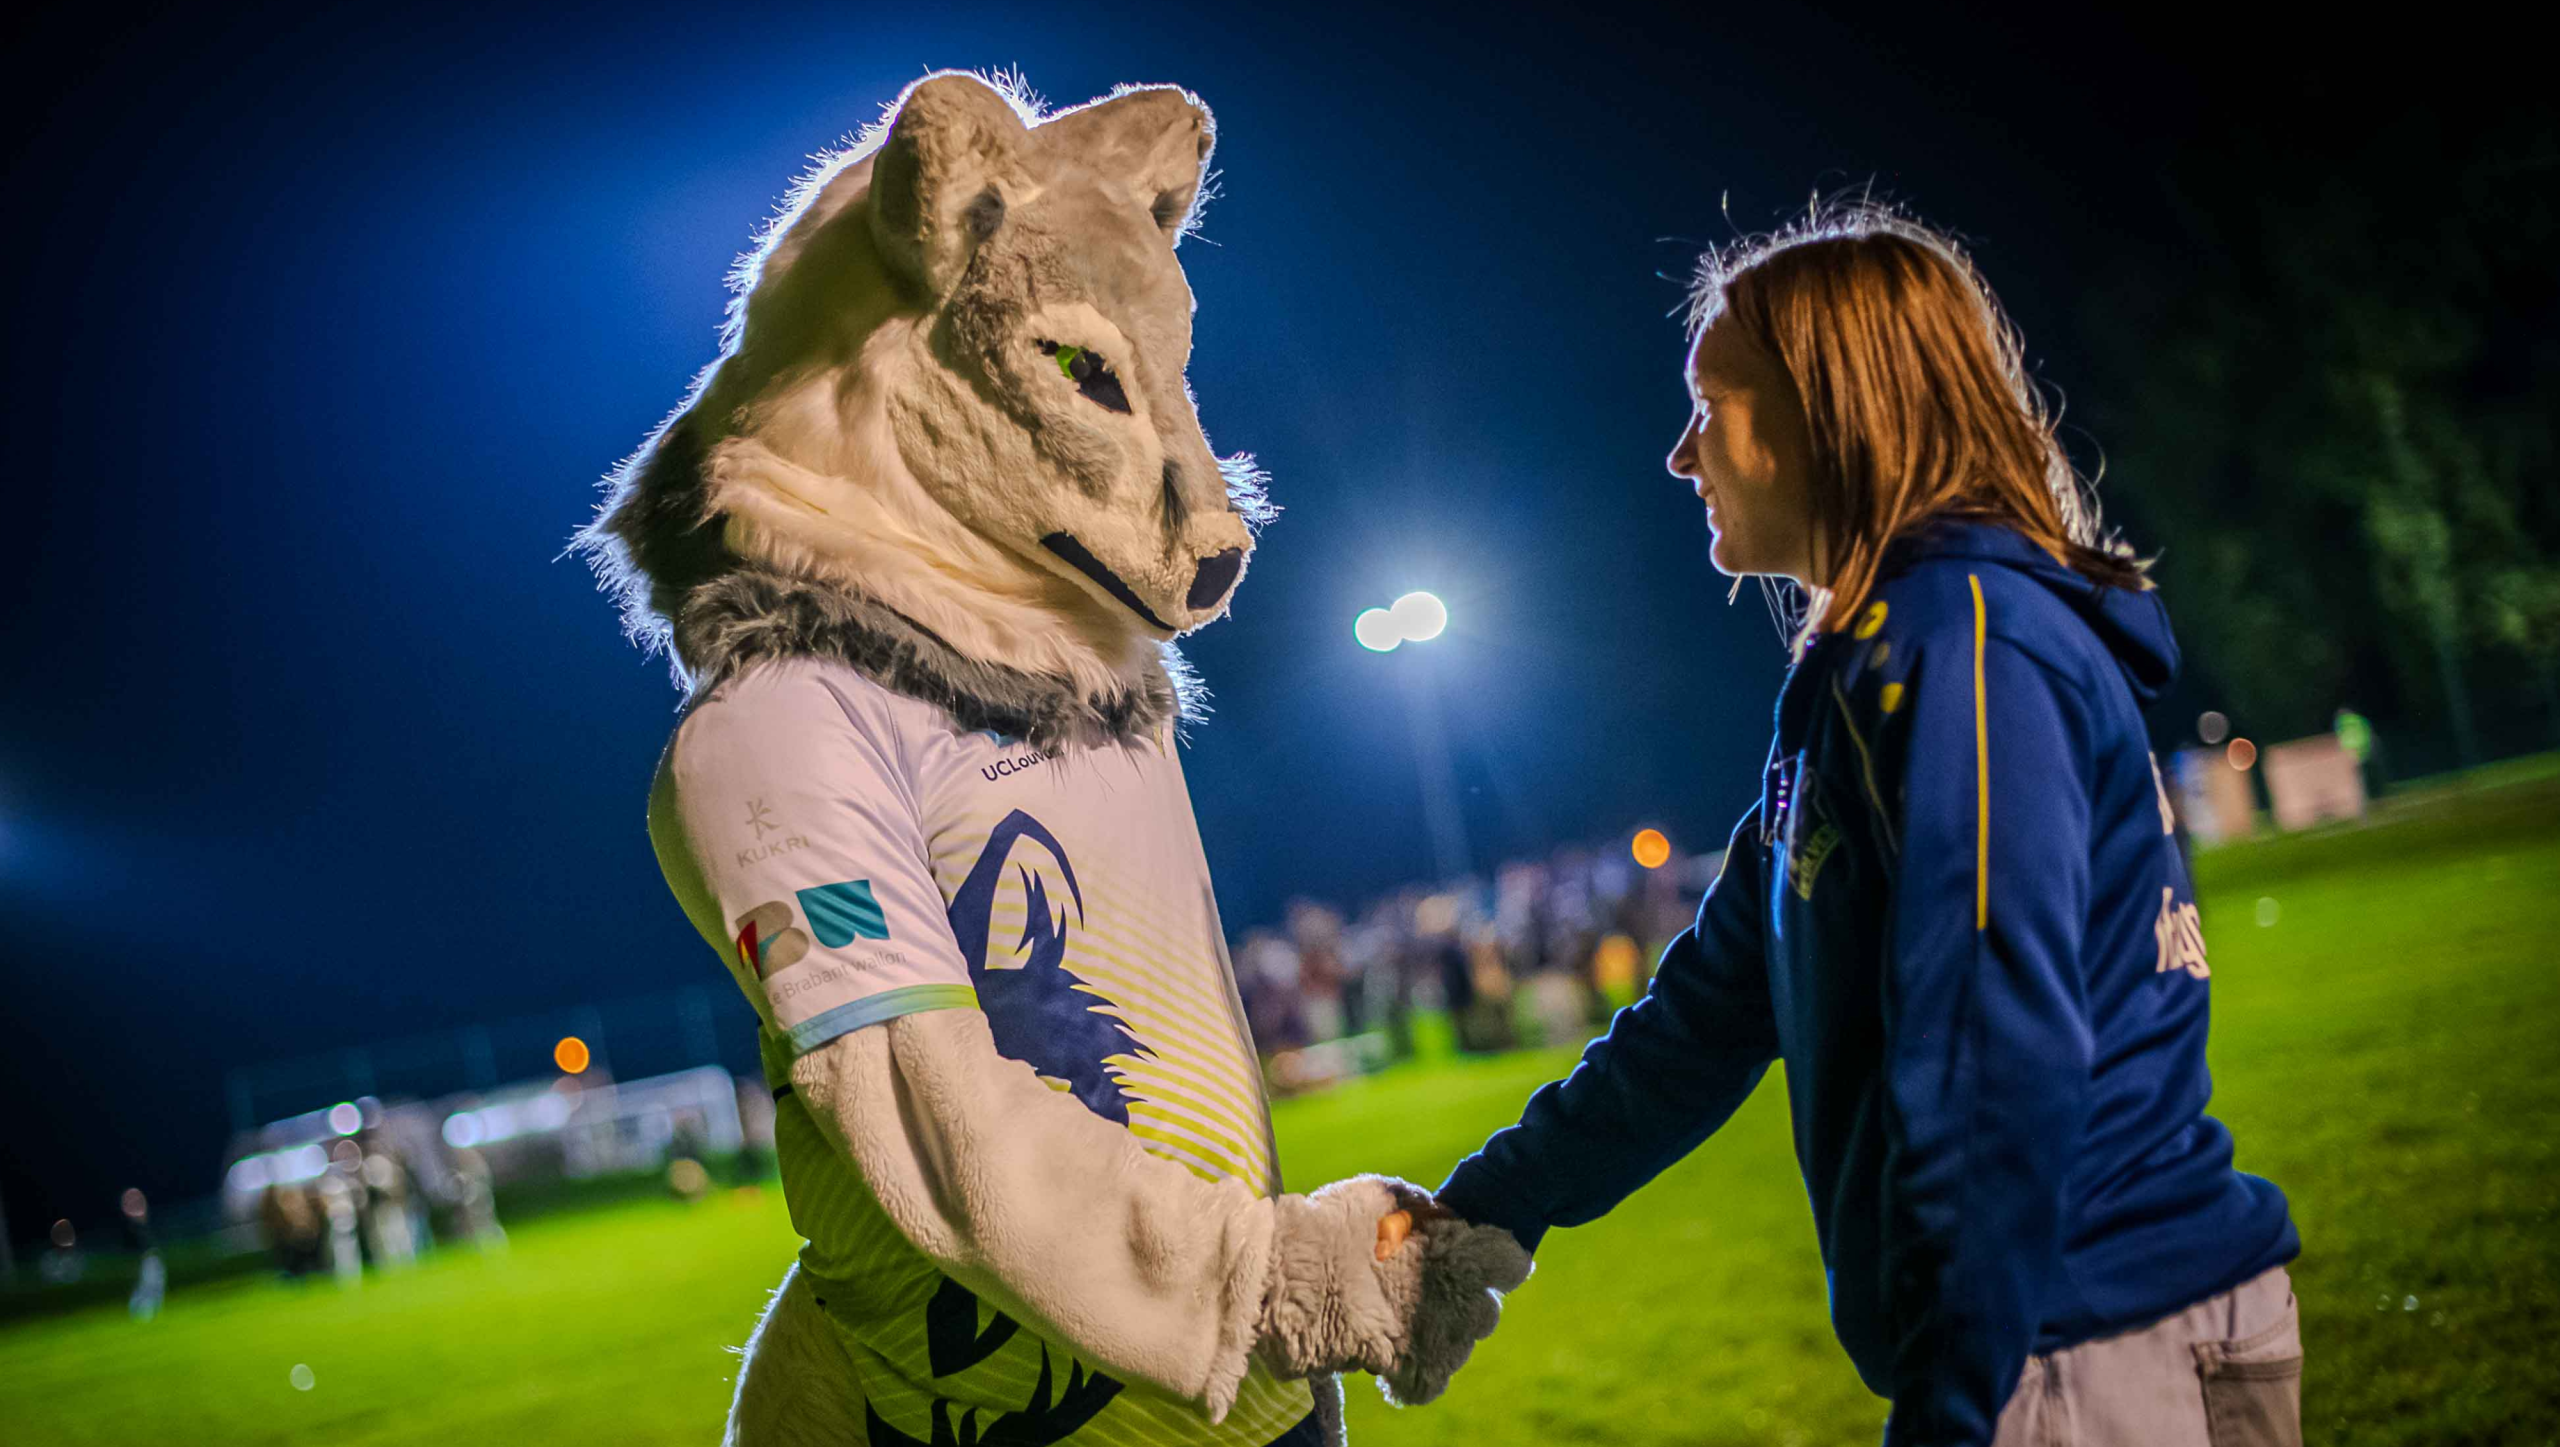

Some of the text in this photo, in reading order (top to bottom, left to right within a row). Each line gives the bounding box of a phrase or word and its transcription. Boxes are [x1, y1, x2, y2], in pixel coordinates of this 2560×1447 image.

[735, 836, 811, 868] KUKRI
[782, 964, 849, 999] Brabant
[851, 950, 907, 973] wallon
